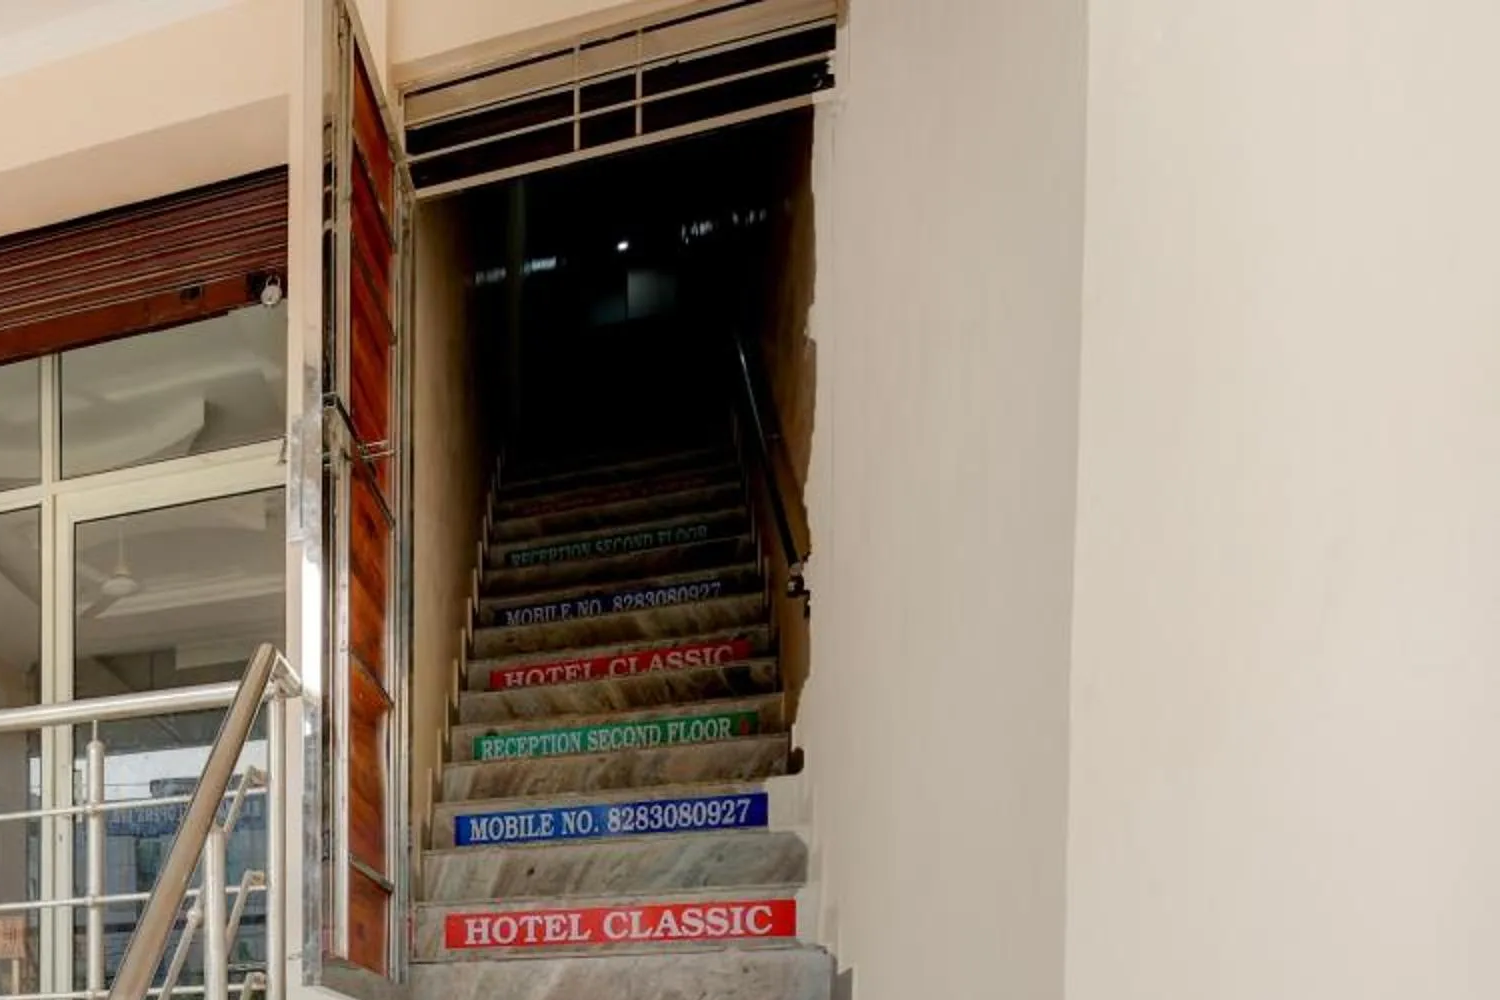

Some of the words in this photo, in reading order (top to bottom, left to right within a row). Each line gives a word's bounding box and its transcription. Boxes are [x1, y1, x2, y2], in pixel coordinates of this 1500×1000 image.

[577, 598, 602, 616] NO
[504, 661, 600, 687] HOTEL
[608, 644, 734, 676] CLASSIC
[481, 727, 581, 760] RECEPTION
[587, 723, 660, 751] SECOND
[667, 717, 732, 745] FLOOR
[469, 813, 554, 841] MOBILE
[561, 810, 599, 834] NO.
[607, 799, 751, 832] 8283080927
[464, 913, 592, 945] HOTEL
[603, 905, 773, 939] CLASSIC
